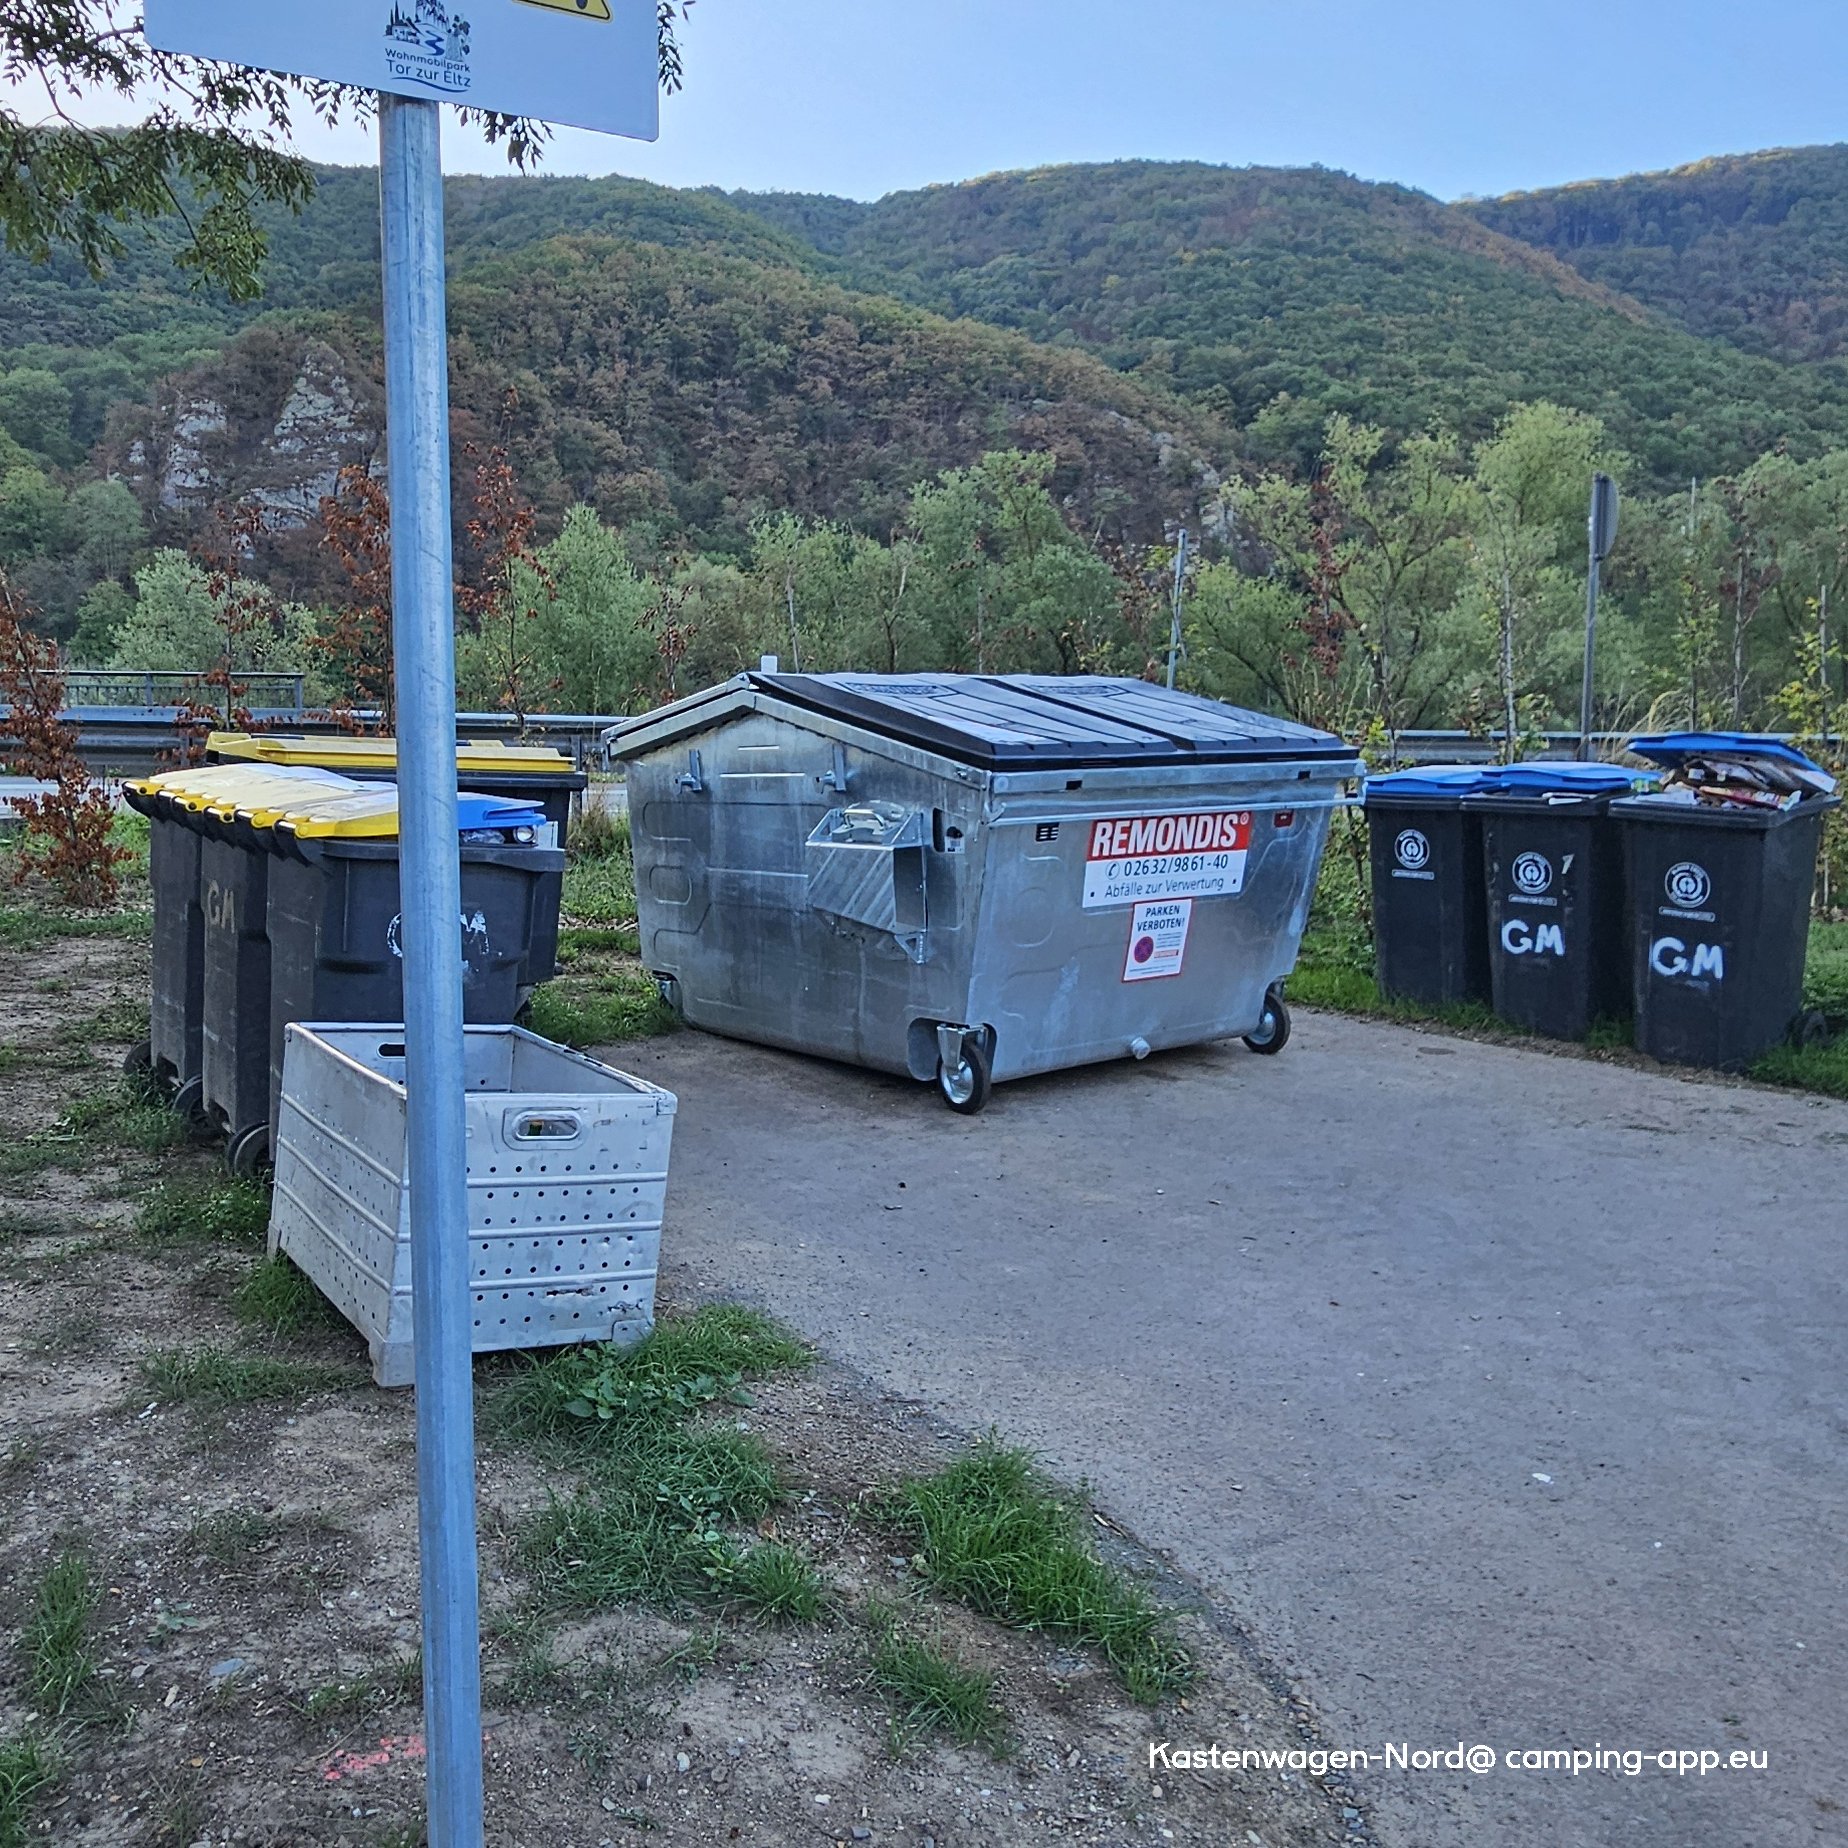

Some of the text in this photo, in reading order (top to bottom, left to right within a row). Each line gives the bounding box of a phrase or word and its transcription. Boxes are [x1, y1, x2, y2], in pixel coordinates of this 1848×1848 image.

[385, 48, 471, 72] Wohnmobilpark
[385, 59, 471, 87] Tor zur Eltz
[1092, 813, 1239, 857] REMONDIS
[1124, 854, 1228, 877] 02632/9861-40
[1105, 877, 1225, 898] Abfälle zur Verwertung
[1145, 905, 1180, 917] PARKEN
[1137, 918, 1185, 931] VERBOTEN!
[1502, 919, 1566, 956] GM
[1652, 937, 1723, 980] GM
